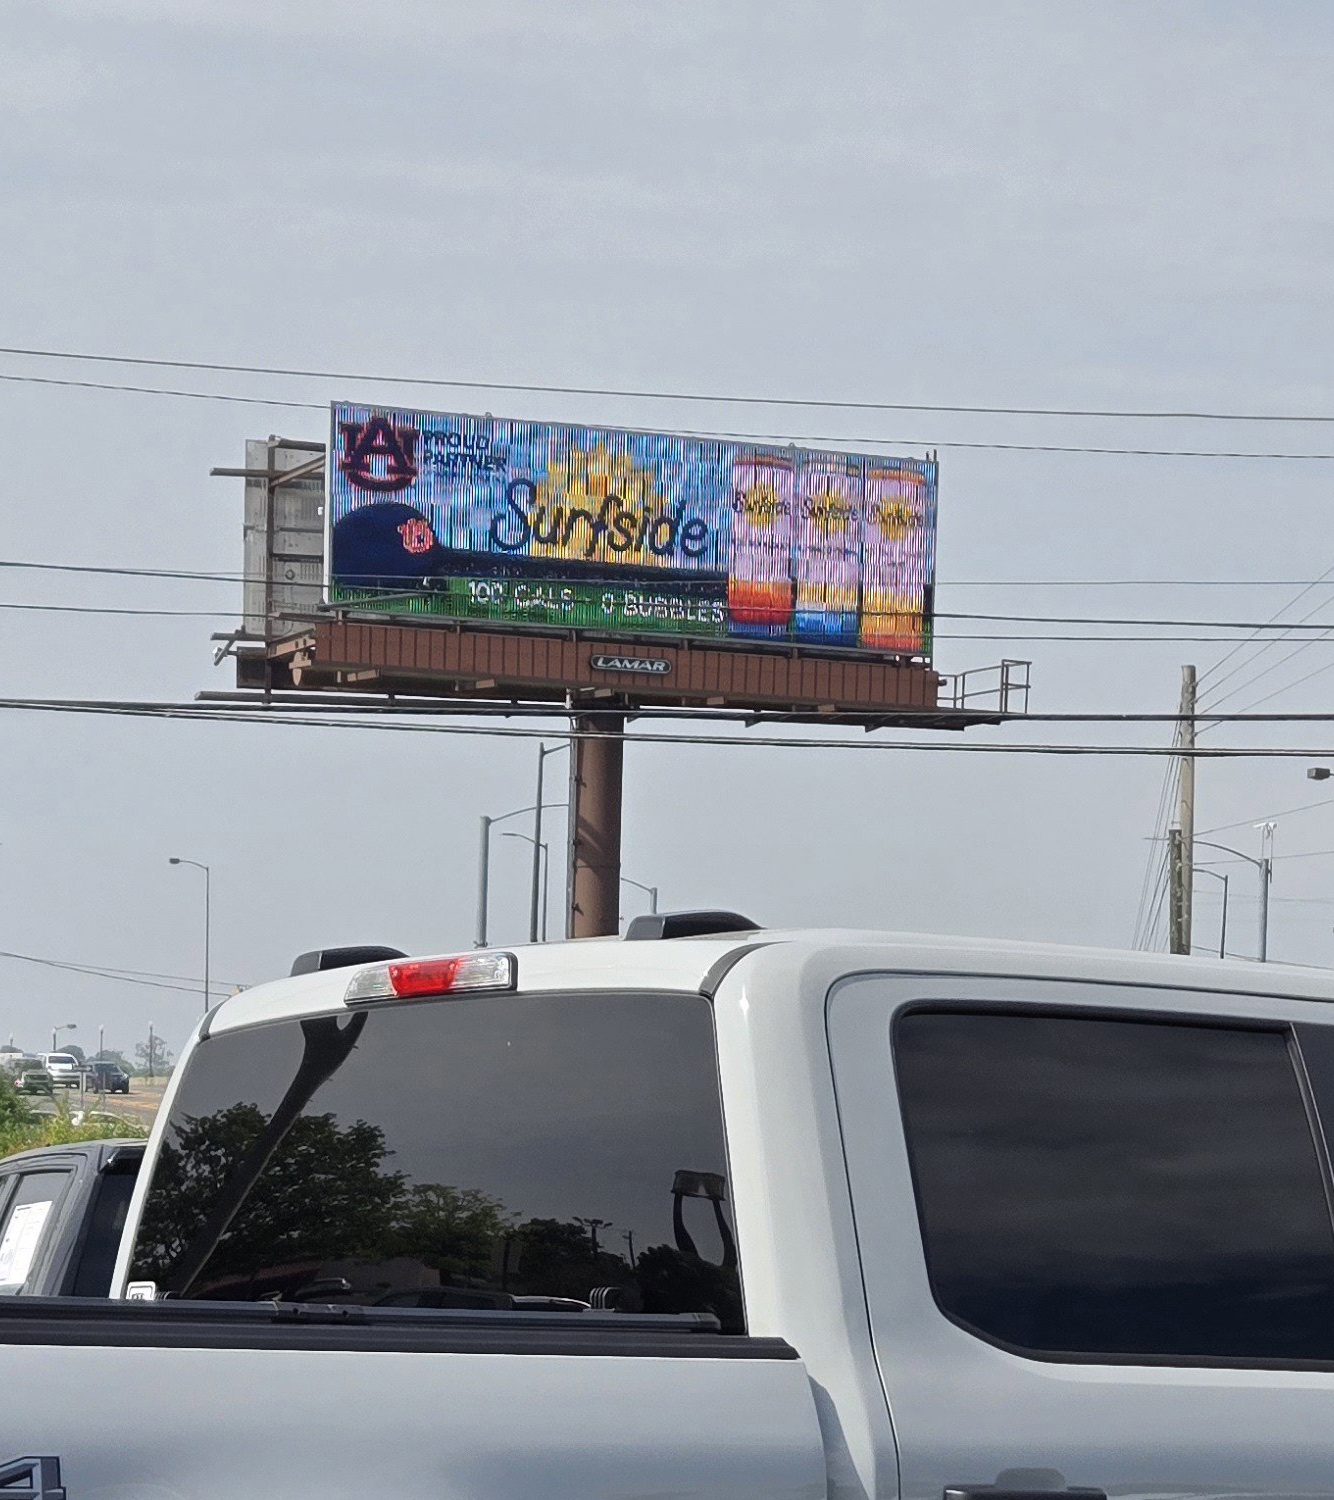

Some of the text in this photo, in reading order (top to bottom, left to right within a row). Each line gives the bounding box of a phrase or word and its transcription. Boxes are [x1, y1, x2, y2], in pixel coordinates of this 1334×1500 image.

[489, 477, 710, 558] Surfside
[515, 583, 575, 612] CALS
[623, 589, 727, 624] BUBBLES
[596, 656, 667, 673] LAMAR
